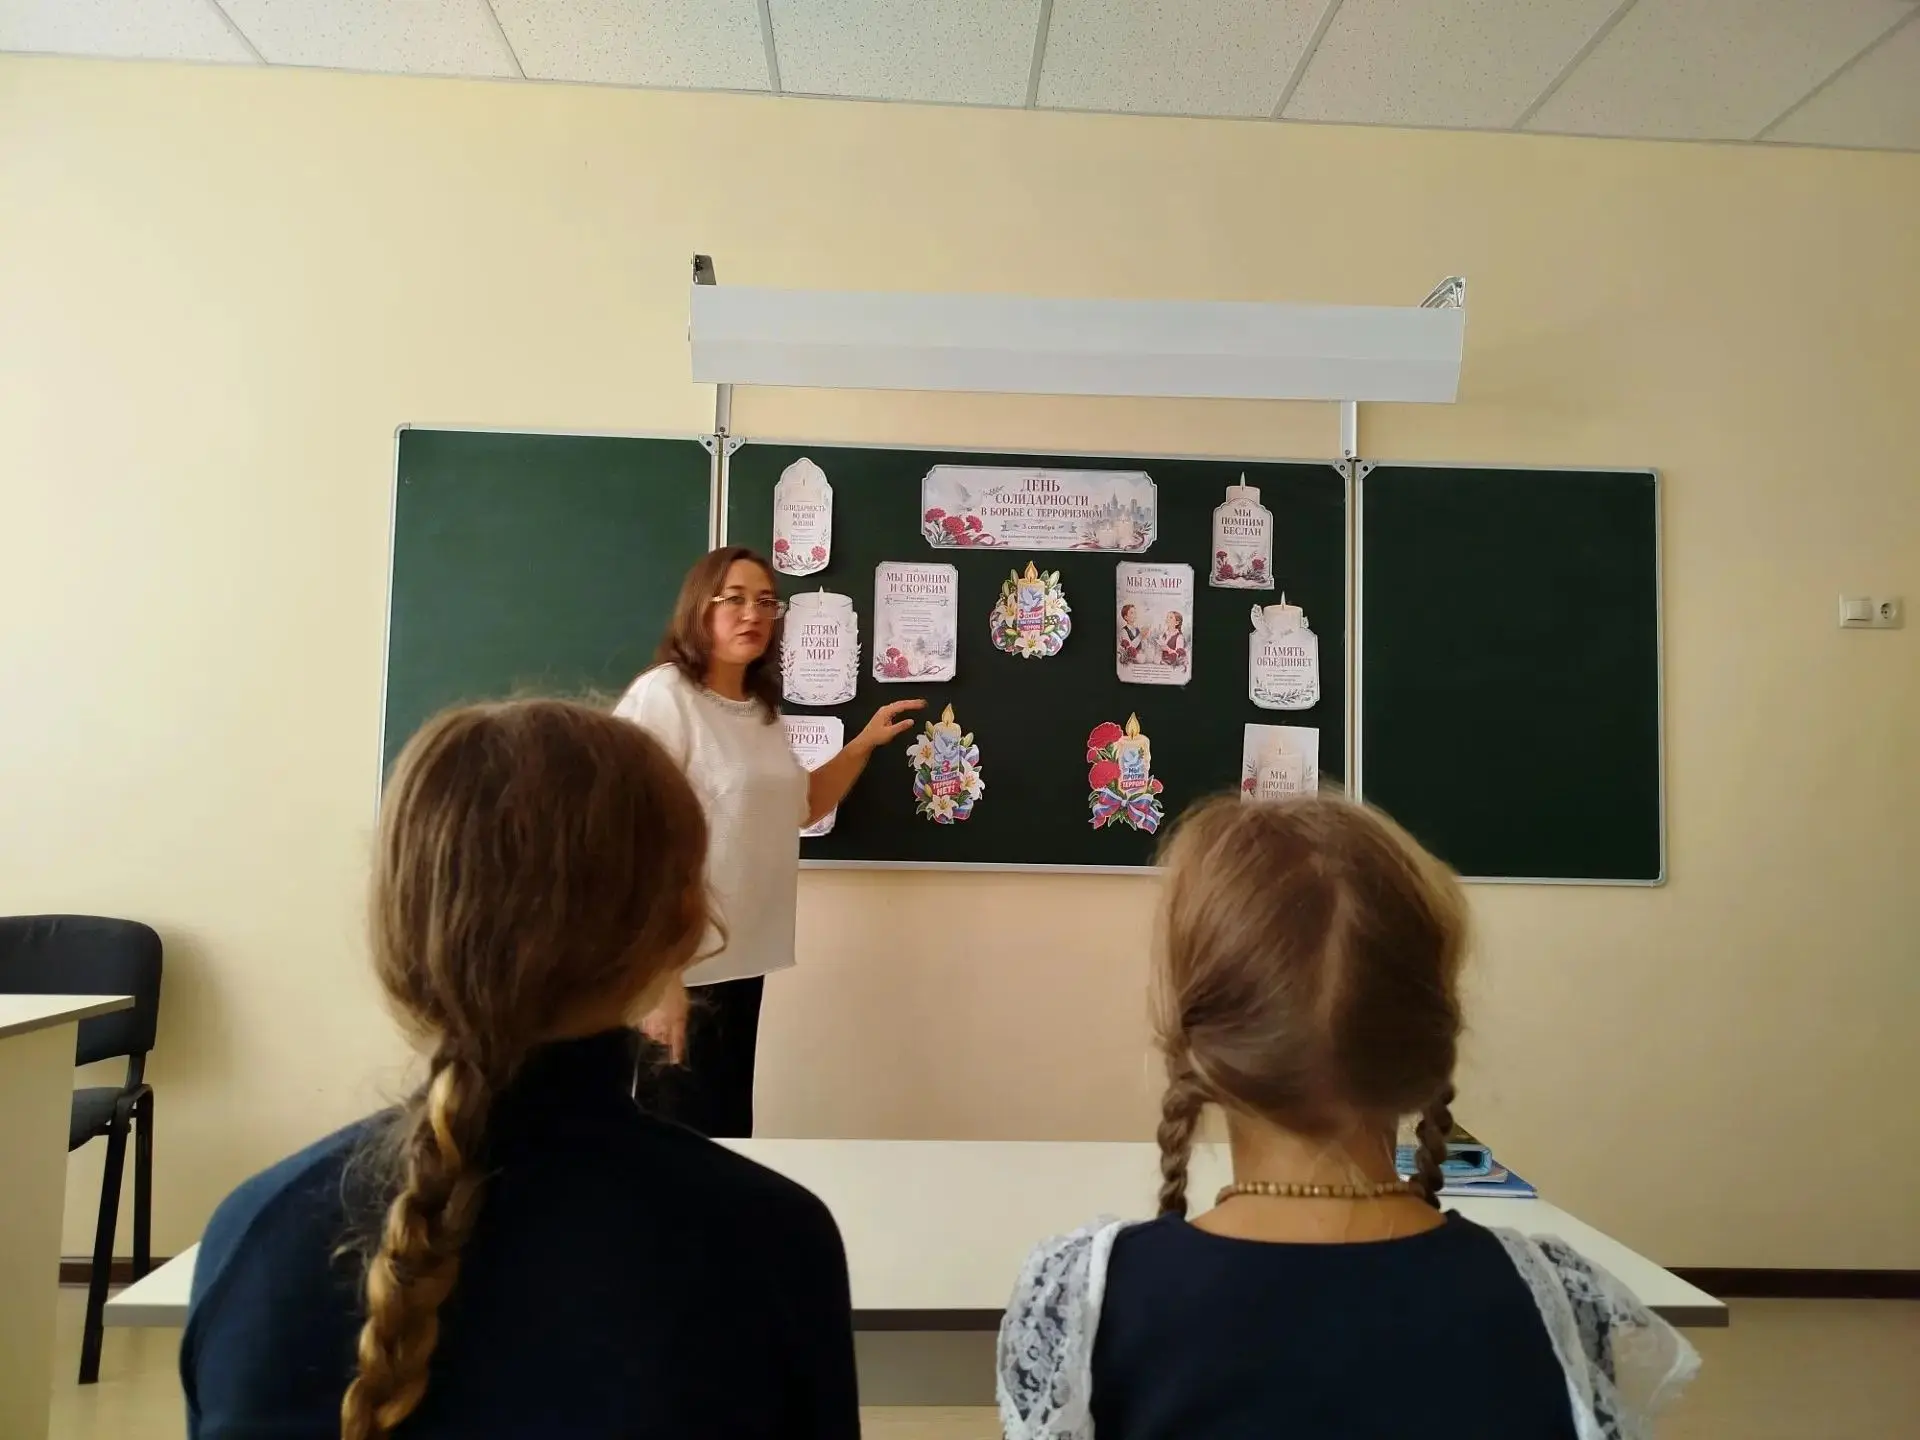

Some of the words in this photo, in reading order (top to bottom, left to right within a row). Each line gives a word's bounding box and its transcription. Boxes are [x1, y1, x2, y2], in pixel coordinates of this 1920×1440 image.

[1020, 479, 1060, 493] ДЕНЬ
[995, 493, 1089, 506] СОЛИДАРНОСТИ
[981, 507, 987, 516] В
[990, 507, 1025, 517] БОРЬБЕ
[1027, 508, 1033, 517] С
[1036, 508, 1103, 519] ТЕРРОРИЗМОМ
[1234, 508, 1252, 517] МЫ
[1221, 516, 1264, 527] ПОМНИМ
[1223, 526, 1261, 536] БЕСЛАН
[887, 572, 903, 582] МЫ
[906, 573, 950, 584] ПОМНИМ
[1126, 576, 1142, 587] МЫ
[1144, 577, 1158, 588] ЗА
[1160, 578, 1182, 588] МИР
[890, 583, 897, 592] И
[900, 584, 947, 594] СКОРБИМ
[1019, 609, 1024, 618] 3
[802, 624, 838, 636] ДЕТЯМ
[801, 637, 839, 648] НУЖЕН
[806, 648, 835, 660] МИР
[1264, 646, 1305, 656] ПАМЯТЬ
[1257, 656, 1313, 668] ОБЪЕДИНЯЕТ
[942, 760, 950, 772] 3
[1270, 770, 1287, 780] МЫ
